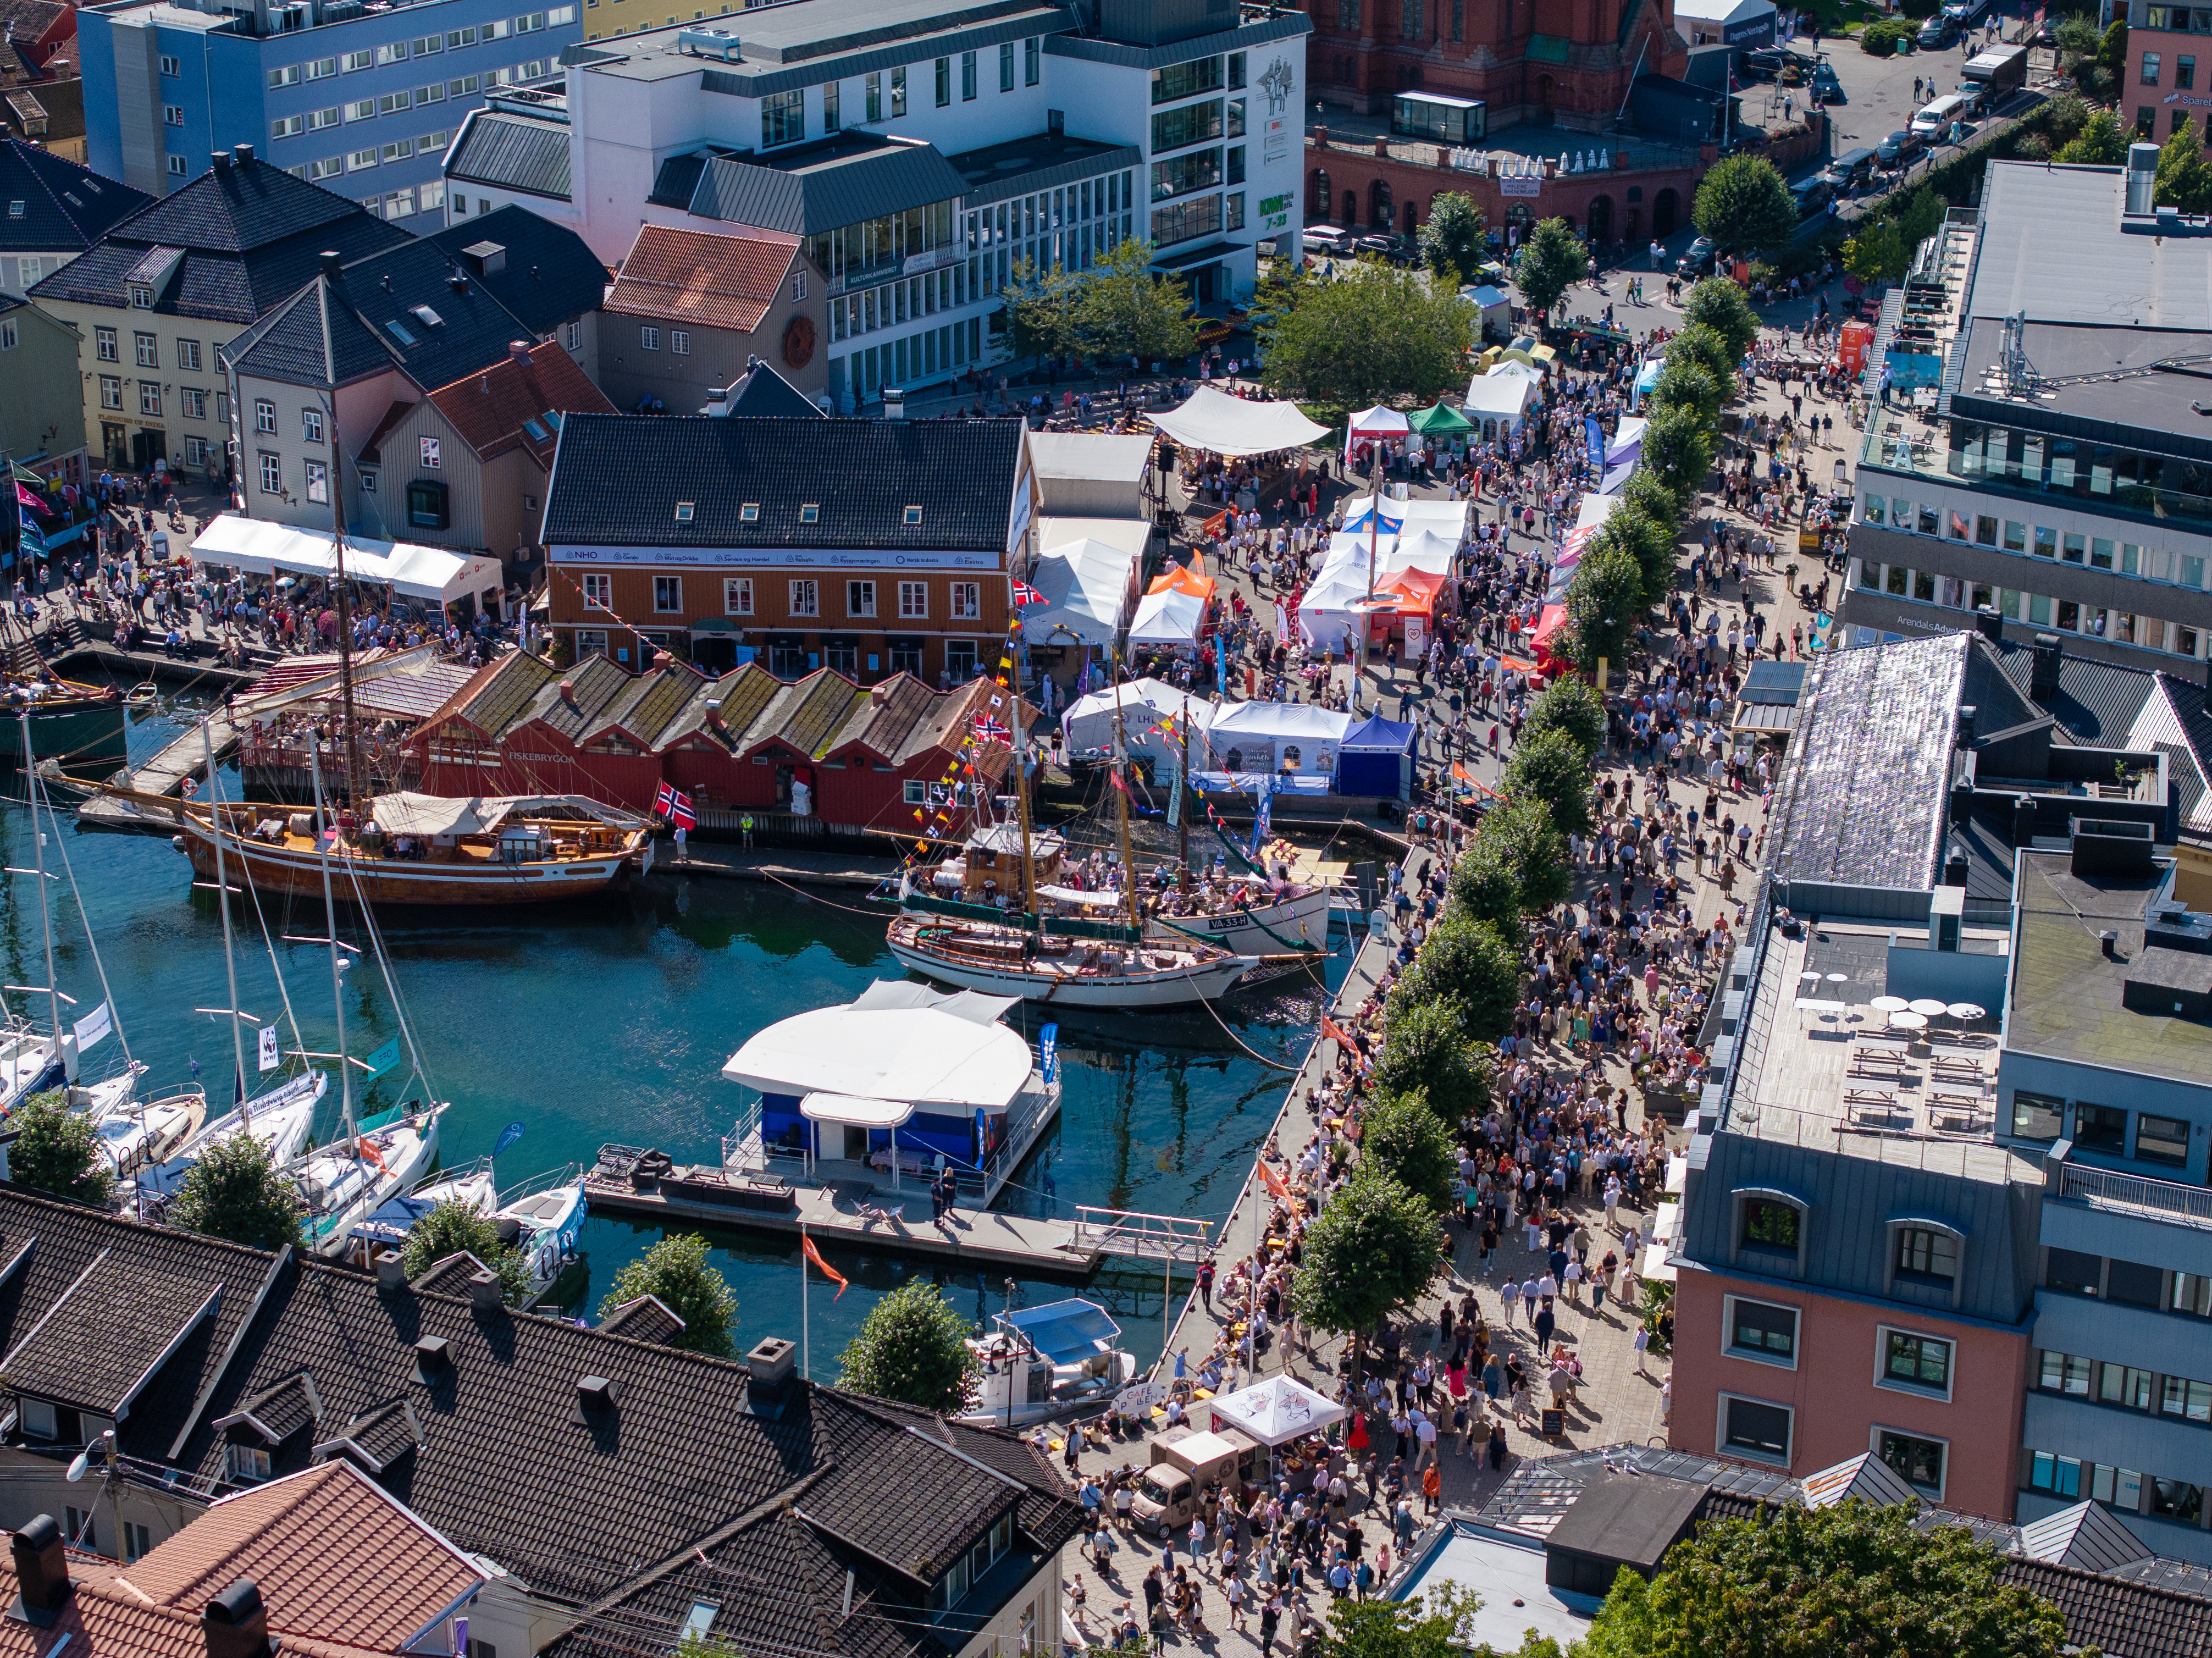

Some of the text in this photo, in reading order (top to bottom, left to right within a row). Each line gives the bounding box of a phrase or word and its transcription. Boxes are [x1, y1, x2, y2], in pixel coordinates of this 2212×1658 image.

[1271, 121, 1282, 130] BRG
[1260, 191, 1294, 217] KIWI mini
[1284, 200, 1293, 211] pris
[850, 266, 898, 284] KULTURKAMMERET
[1848, 331, 1856, 342] 2
[1138, 715, 1157, 724] LHL
[510, 751, 576, 764] FISKEBRYGGA
[1211, 917, 1246, 928] VA-33-H
[264, 1054, 277, 1063] WWF
[1127, 1384, 1152, 1400] CAFÉ
[1121, 1393, 1158, 1411] POLLEN
